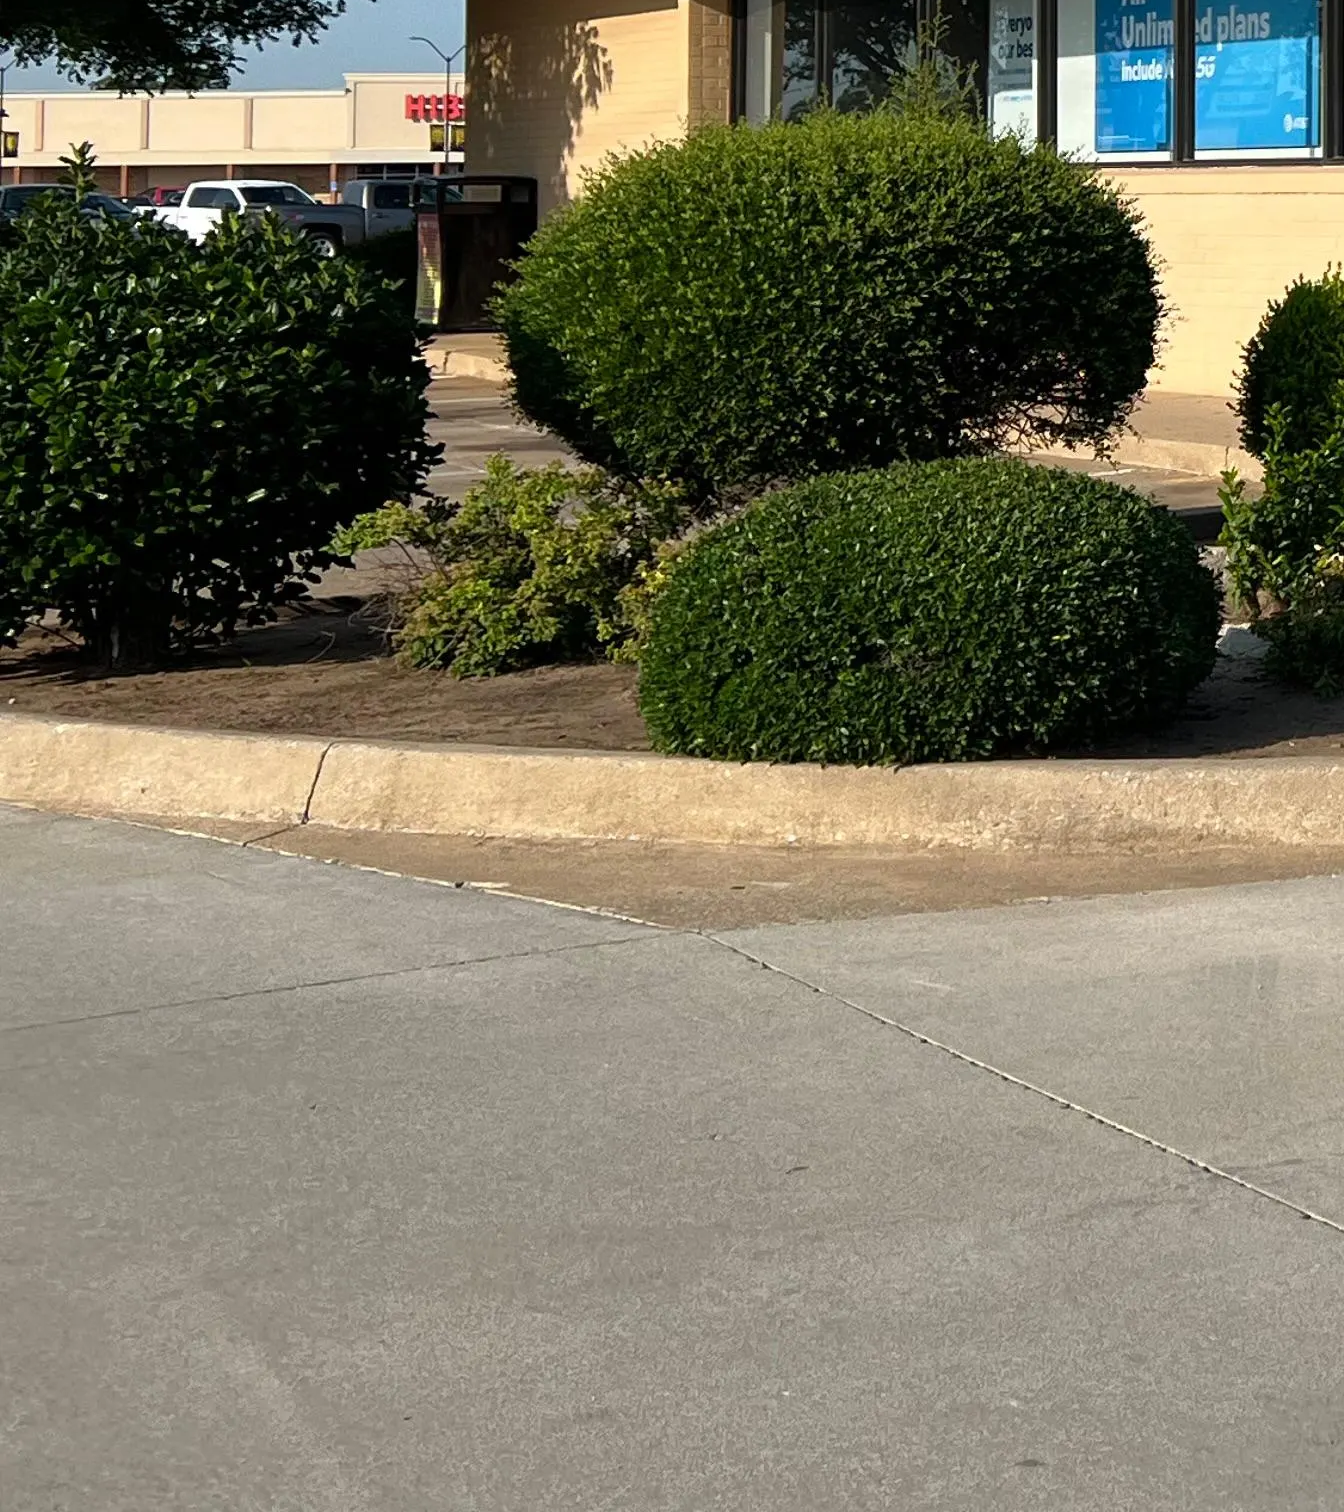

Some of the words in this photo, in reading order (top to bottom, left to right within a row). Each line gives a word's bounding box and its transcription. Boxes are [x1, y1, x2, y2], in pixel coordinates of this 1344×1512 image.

[1121, 7, 1213, 49] Unlimed
[1217, 4, 1271, 51] plans
[1121, 57, 1162, 82] include
[1196, 56, 1216, 79] 5G
[405, 94, 465, 119] HIB
